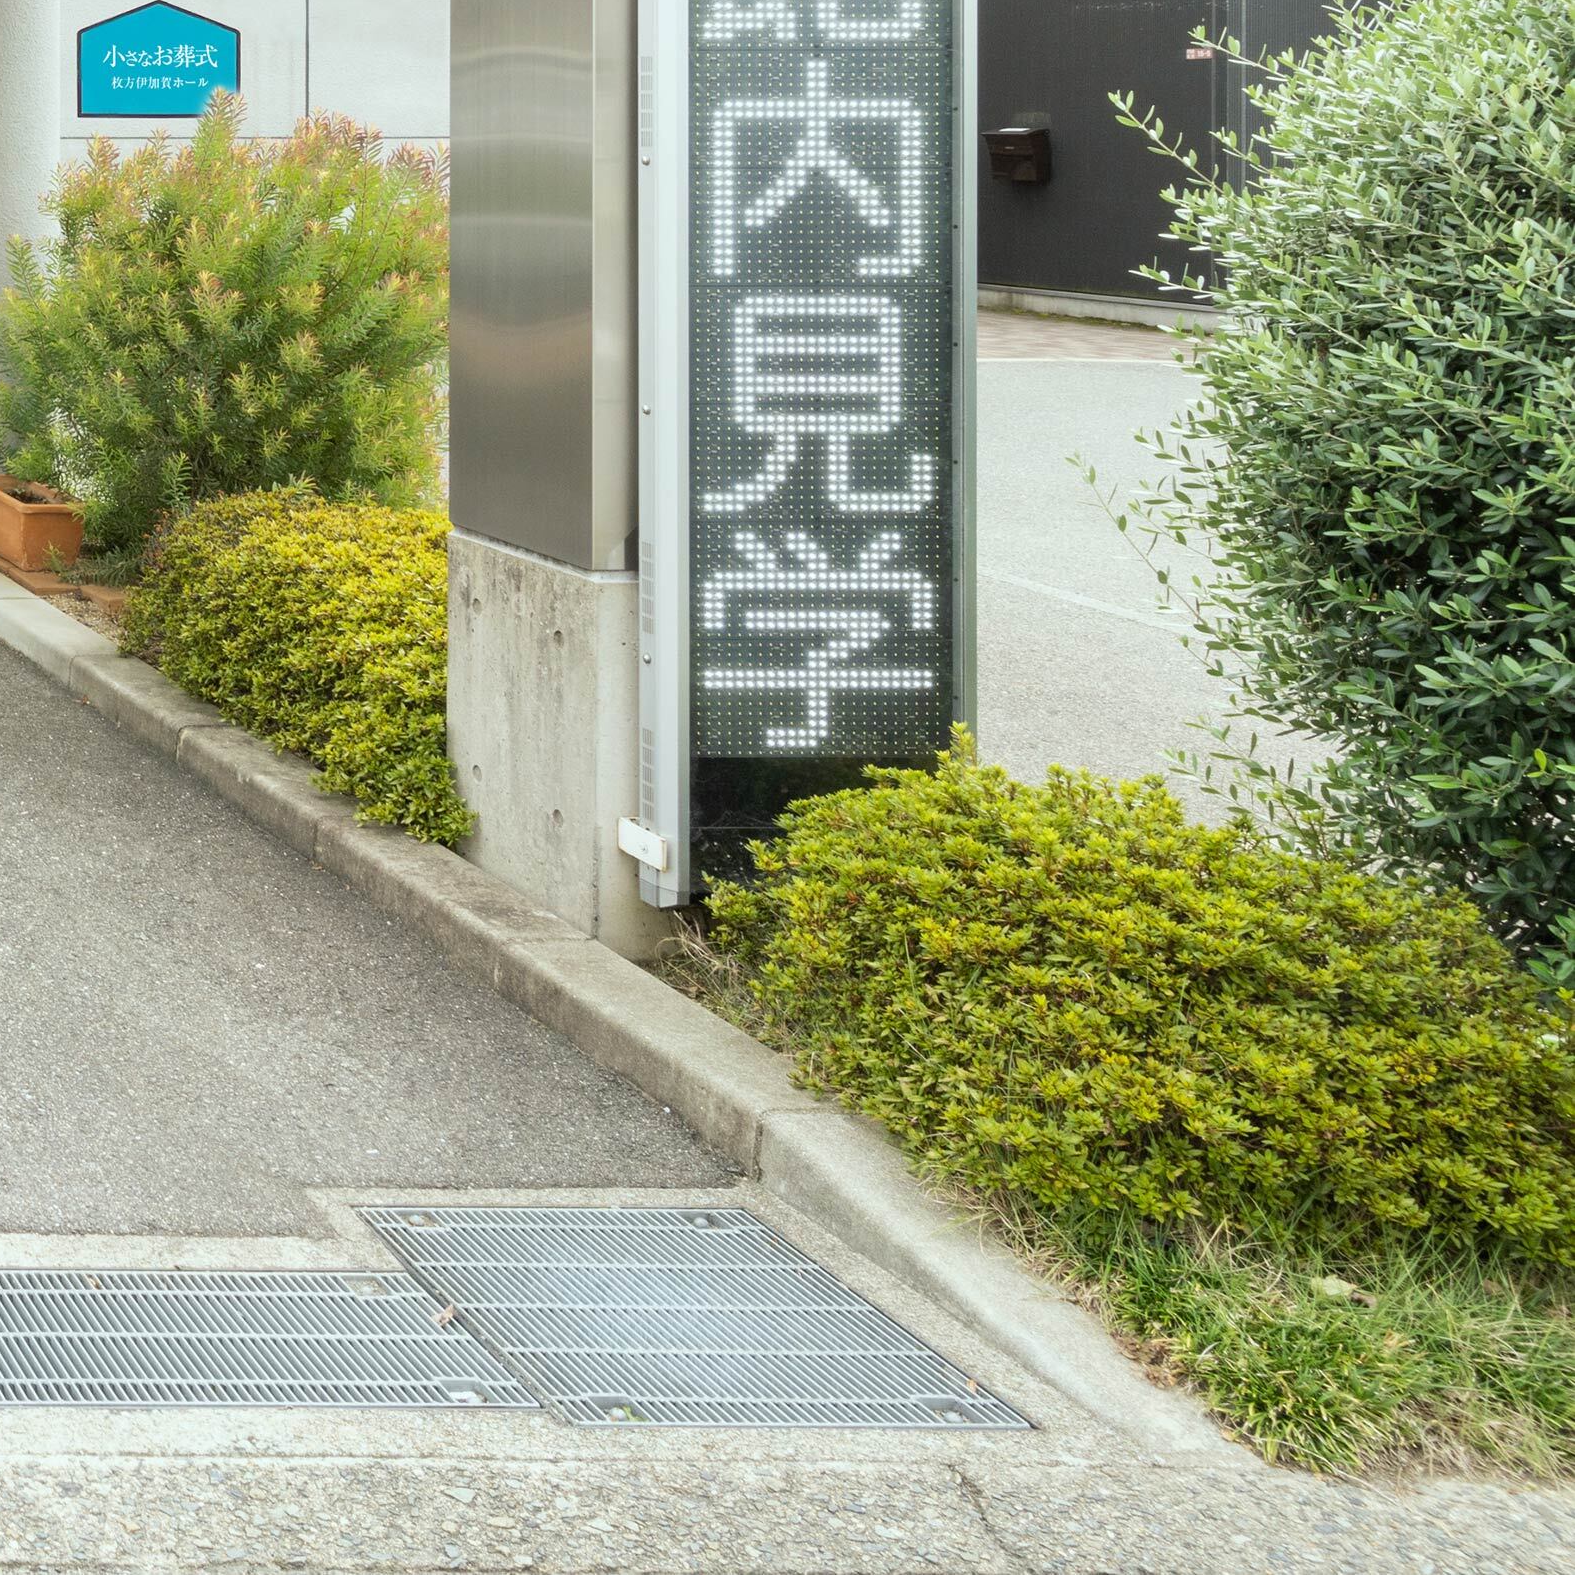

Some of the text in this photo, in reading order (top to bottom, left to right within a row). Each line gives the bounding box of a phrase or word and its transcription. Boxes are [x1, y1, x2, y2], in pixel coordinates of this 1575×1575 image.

[102, 44, 219, 68] 小さなお葬式
[111, 76, 209, 90] 枚方伊加賀ホール
